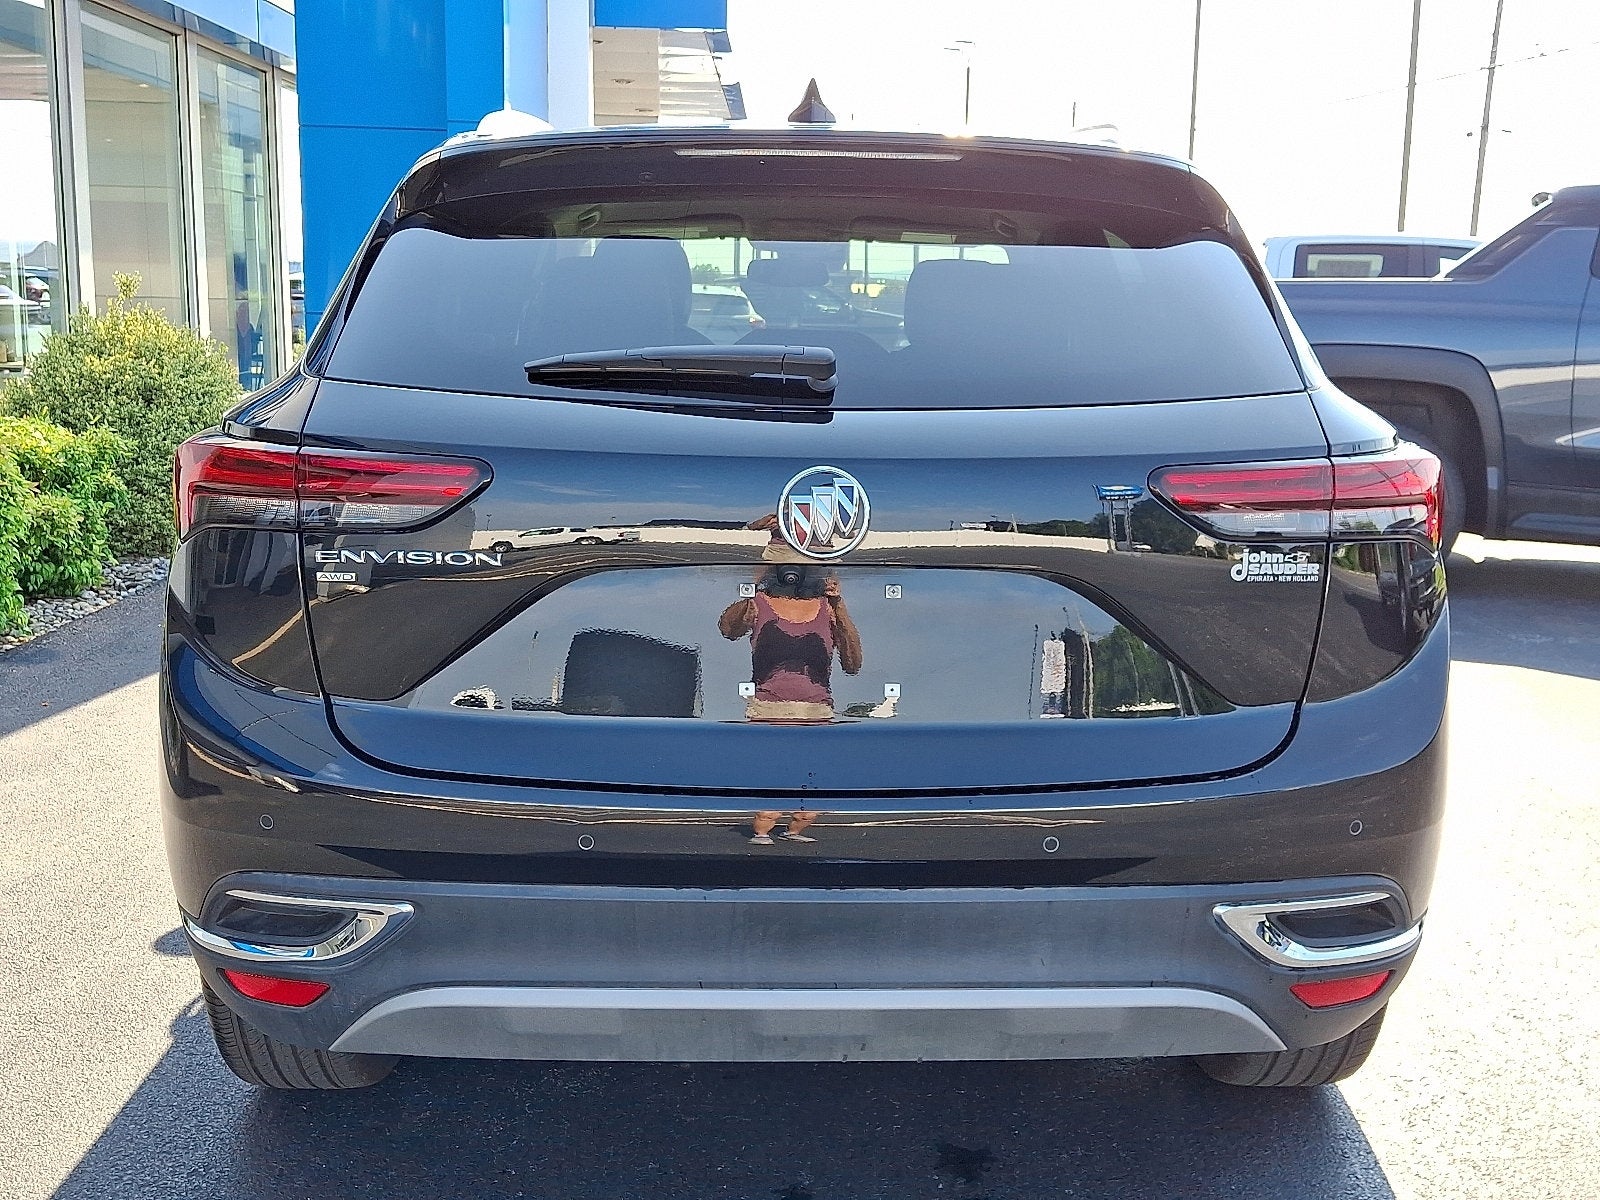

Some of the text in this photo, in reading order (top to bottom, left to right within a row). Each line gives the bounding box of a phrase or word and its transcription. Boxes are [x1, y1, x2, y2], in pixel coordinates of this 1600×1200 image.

[315, 550, 502, 566] ENVISION
[1248, 563, 1320, 575] SAUDER
[318, 573, 354, 581] AWD
